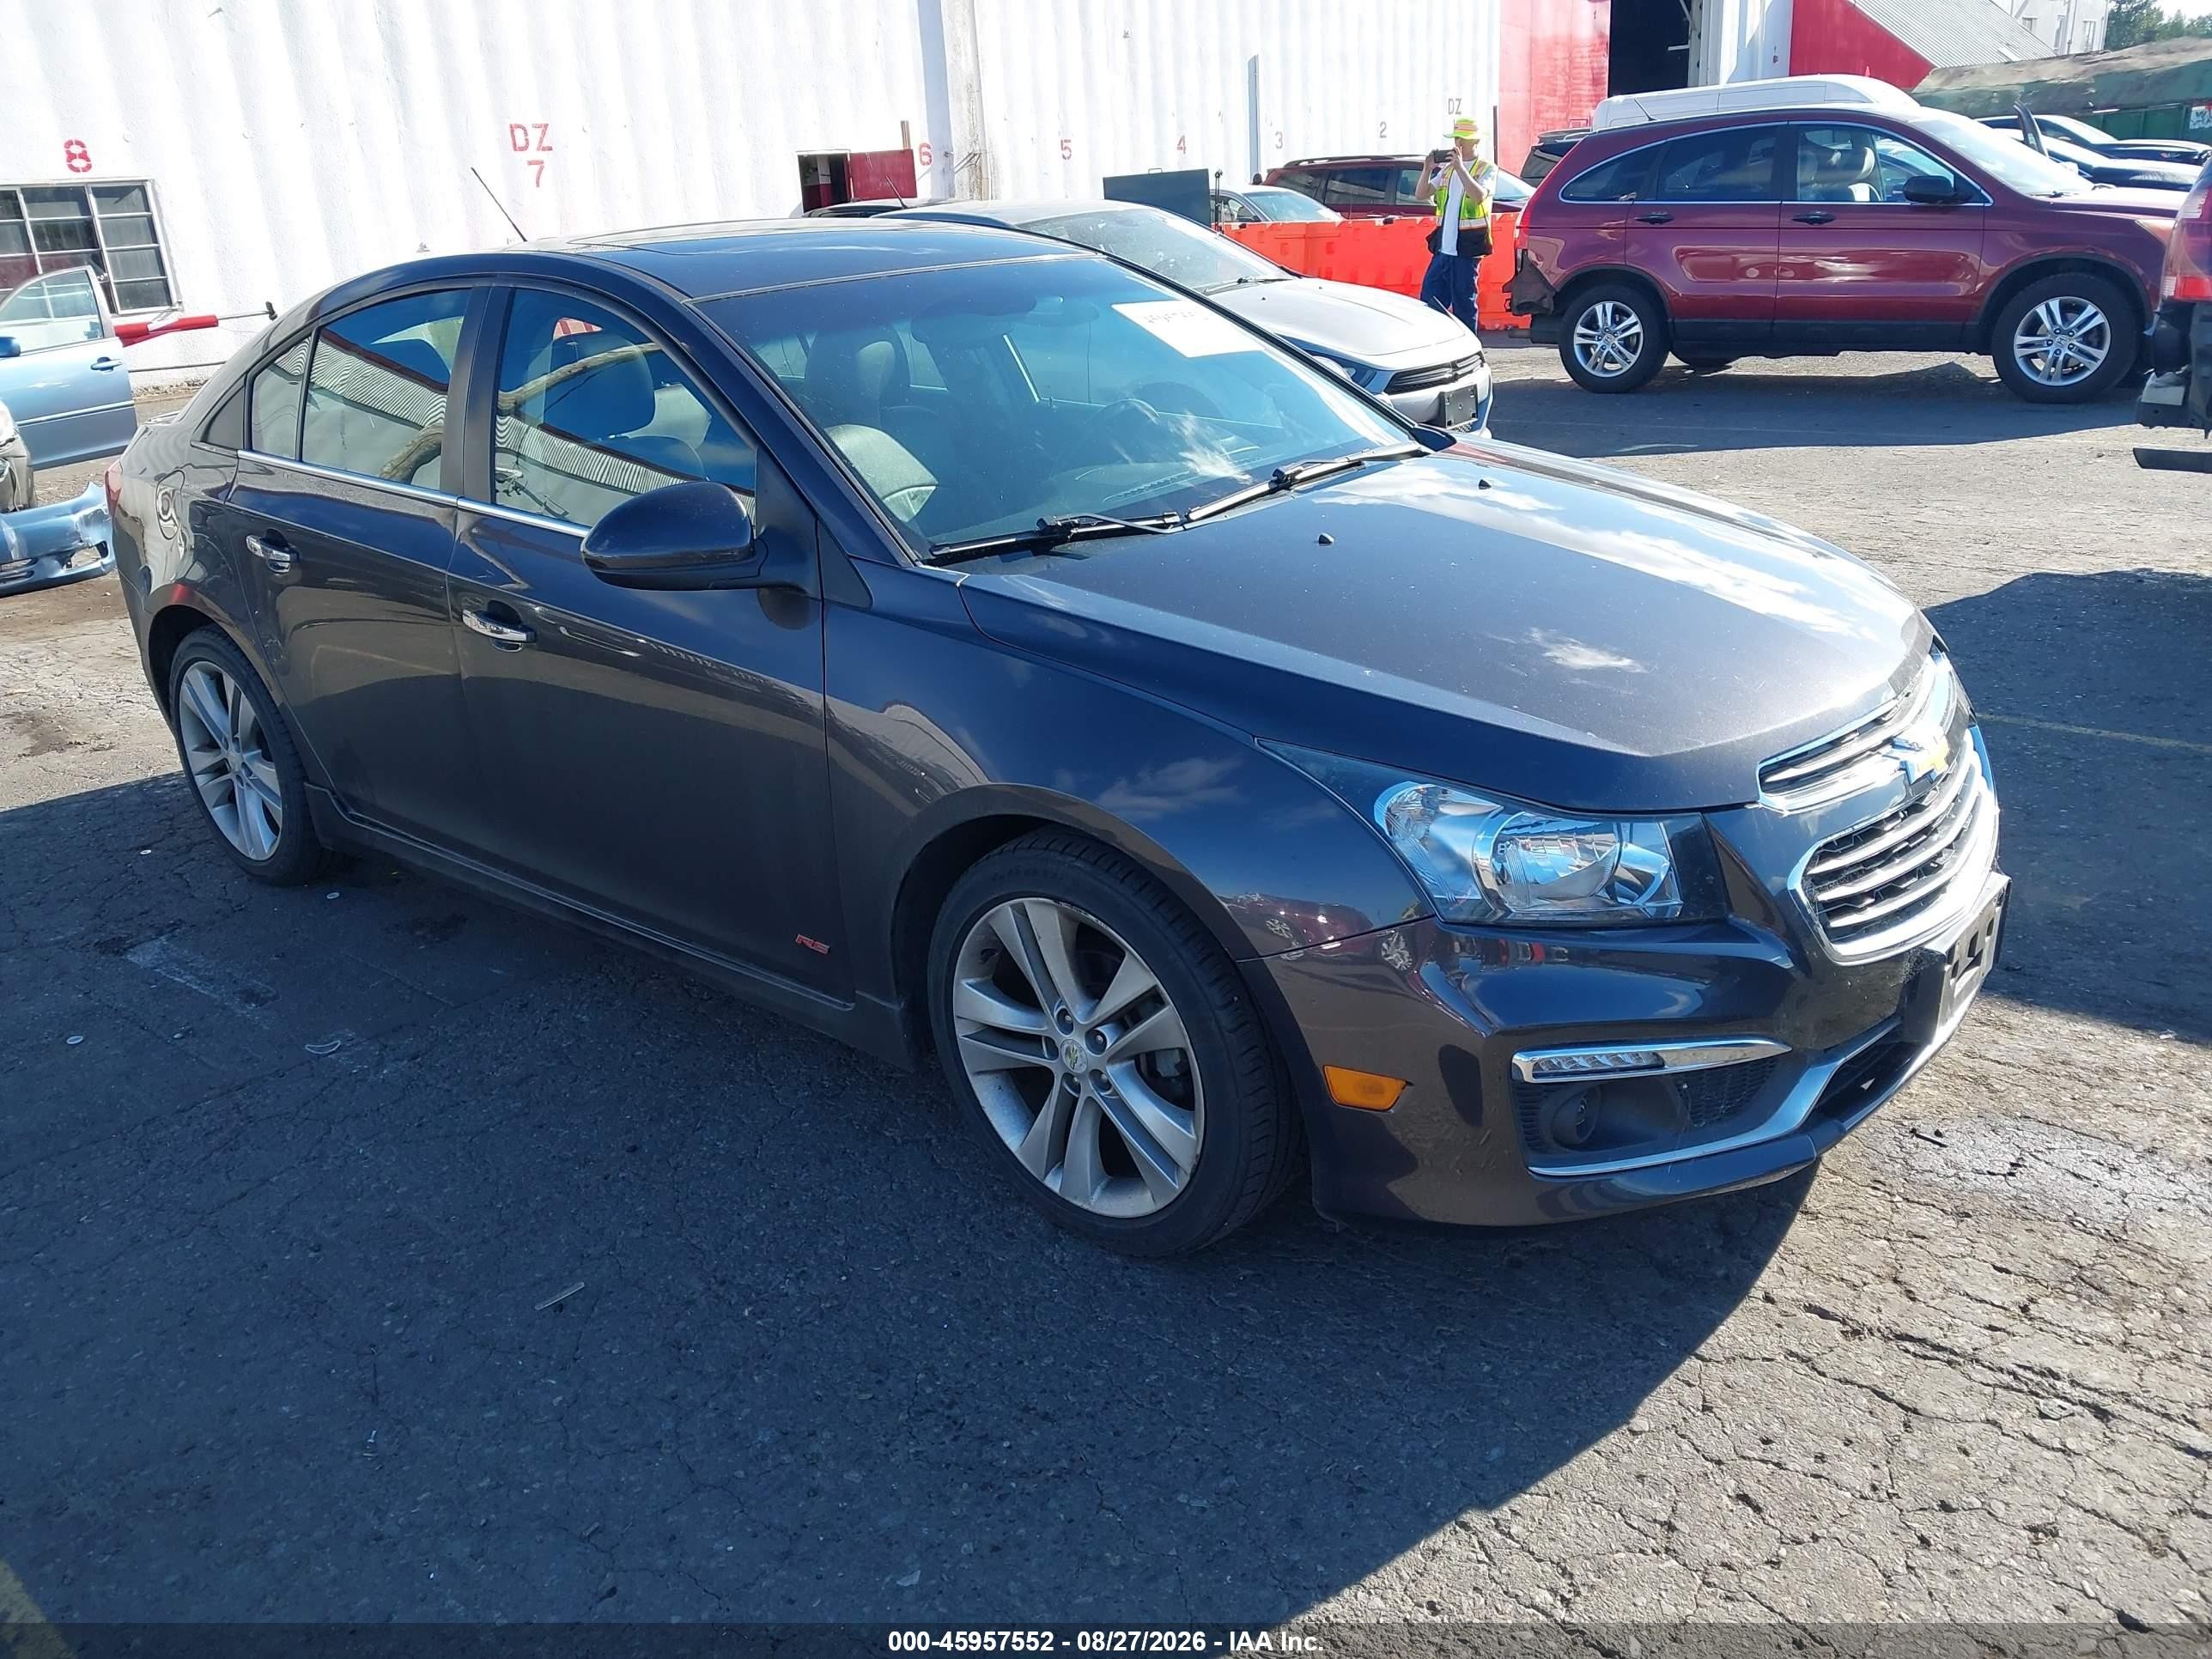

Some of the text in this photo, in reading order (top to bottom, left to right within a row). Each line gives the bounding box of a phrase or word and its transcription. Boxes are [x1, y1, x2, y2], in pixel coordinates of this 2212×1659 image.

[1448, 97, 1462, 115] DZ
[509, 123, 553, 151] DZ
[1274, 131, 1284, 149] 3
[1379, 120, 1388, 138] 2
[64, 138, 93, 173] 8
[918, 143, 933, 167] 6
[1060, 138, 1073, 161] 5
[1176, 134, 1187, 155] 4
[526, 159, 545, 188] 7
[795, 933, 830, 955] RS
